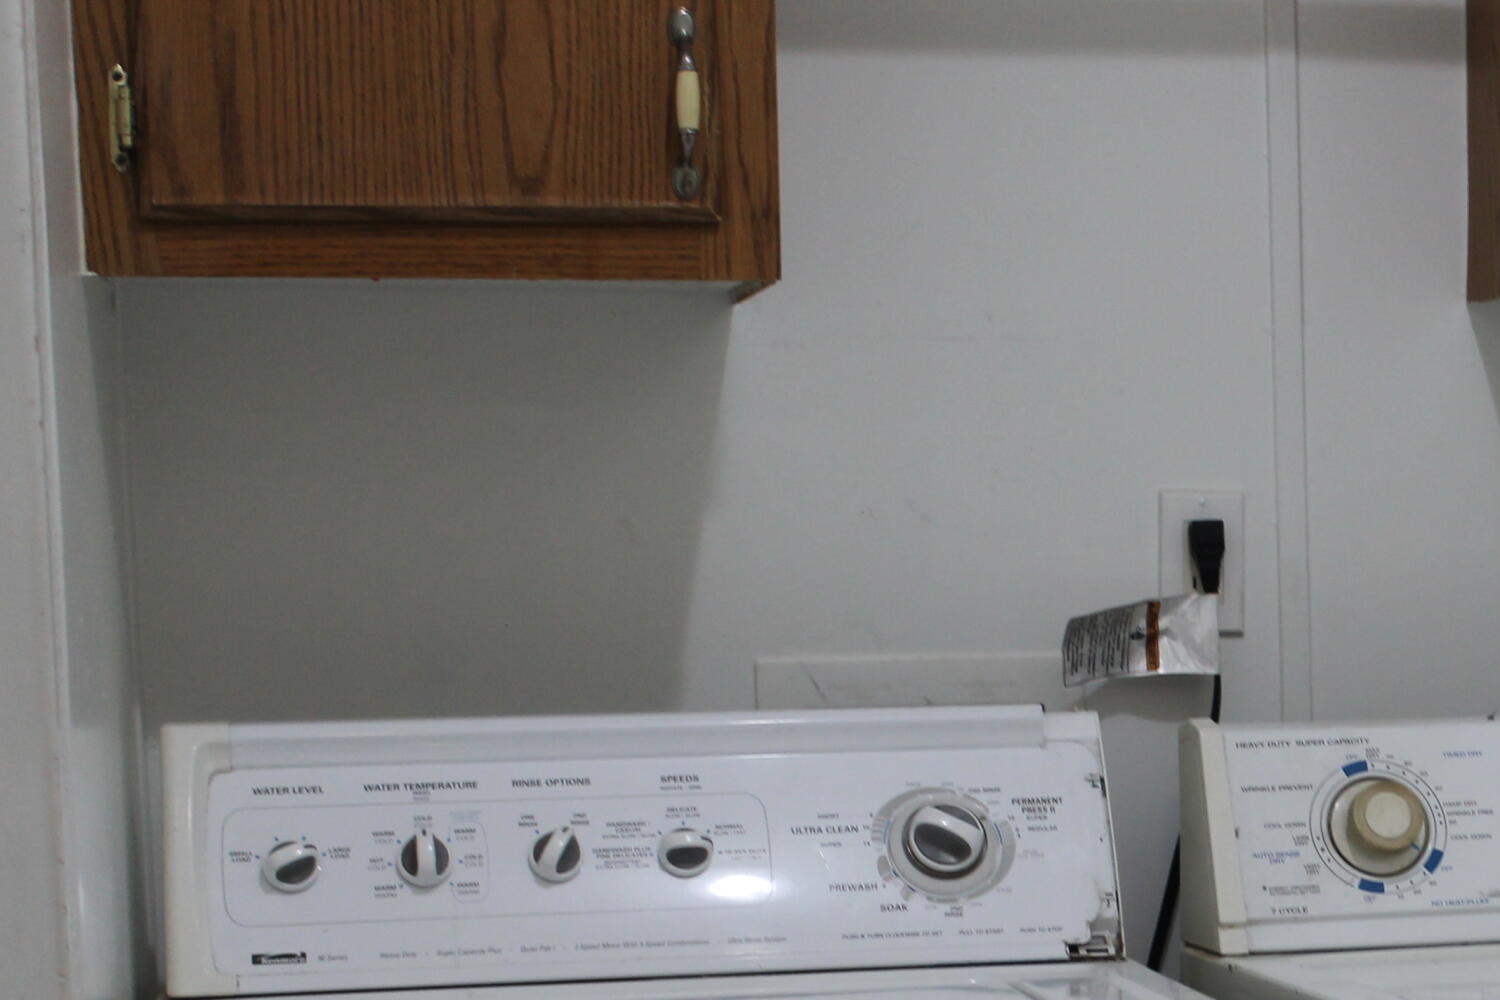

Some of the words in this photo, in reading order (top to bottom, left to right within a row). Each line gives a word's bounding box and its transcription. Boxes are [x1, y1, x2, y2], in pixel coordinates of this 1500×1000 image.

[1235, 740, 1265, 749] HEAVY
[1267, 739, 1291, 748] DUTY
[511, 779, 542, 788] RINSE
[544, 777, 592, 787] OPTIONS
[660, 774, 700, 784] SPEEDS
[252, 785, 291, 796] WATER
[292, 784, 325, 794] LEVEL
[363, 783, 400, 793] WATER
[403, 780, 479, 792] TEMPERATURE
[1010, 796, 1064, 807] PERMANENT
[1020, 806, 1046, 815] PRESS
[790, 825, 825, 836] ULTRA
[826, 823, 859, 834] CLEAN
[828, 882, 879, 892] PREWASH
[880, 903, 909, 913] SOAK
